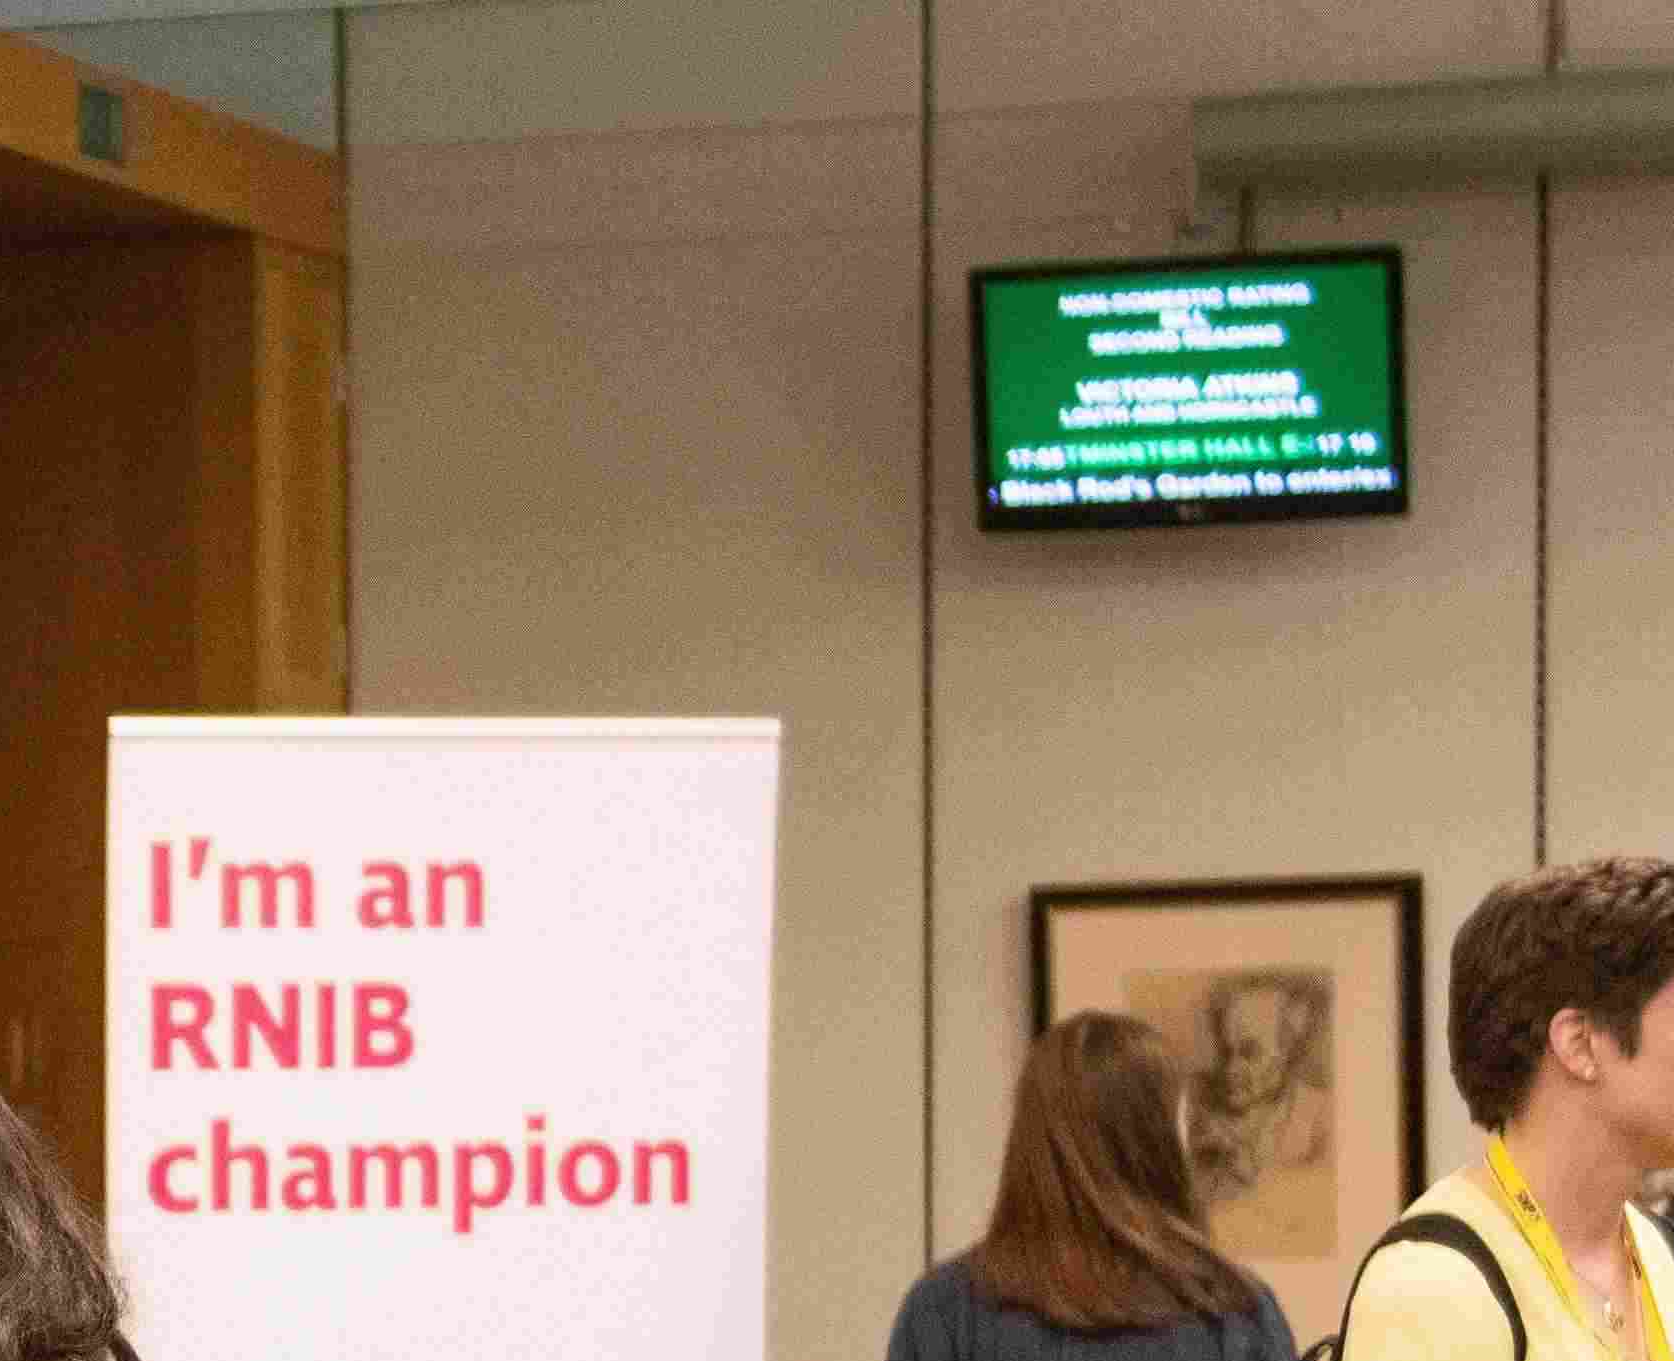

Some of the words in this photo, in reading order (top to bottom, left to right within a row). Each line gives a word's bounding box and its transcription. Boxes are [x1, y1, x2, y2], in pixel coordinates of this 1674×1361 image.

[150, 836, 316, 929] I'm
[355, 859, 486, 929] an
[150, 982, 416, 1071] RNIB
[147, 1112, 691, 1234] champion
